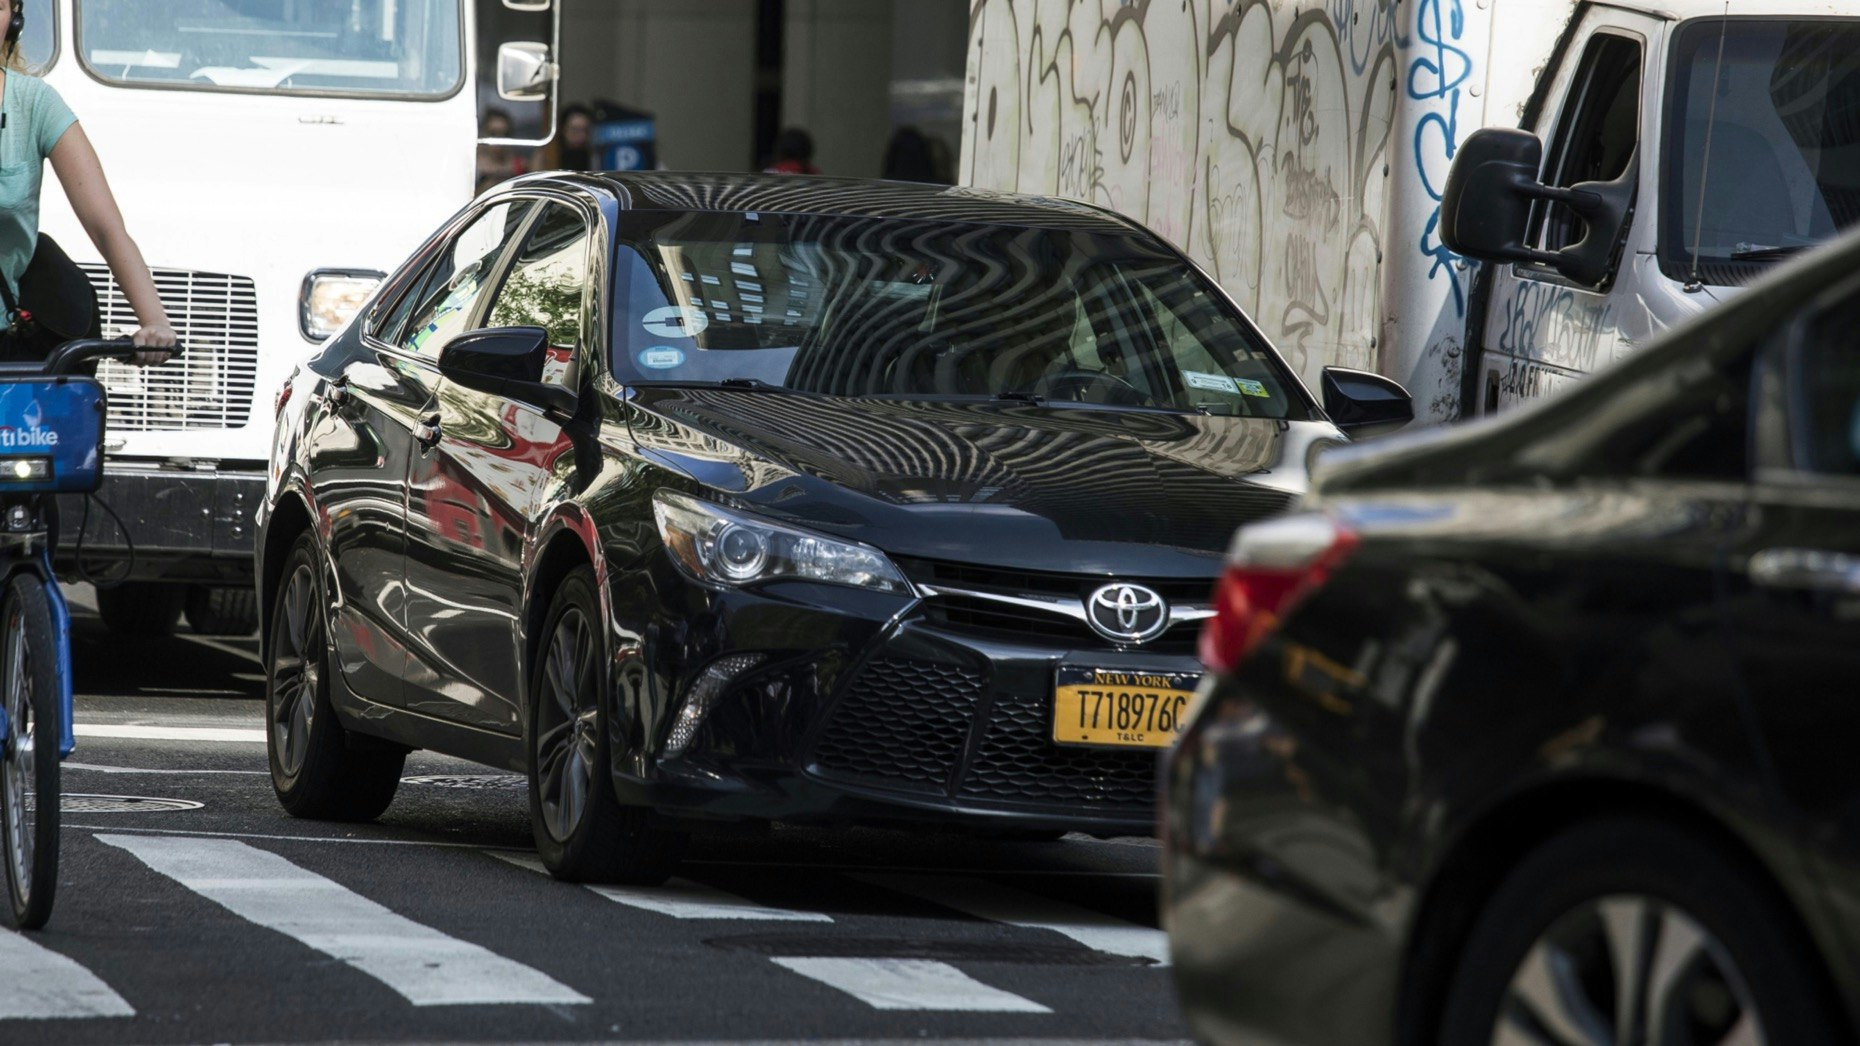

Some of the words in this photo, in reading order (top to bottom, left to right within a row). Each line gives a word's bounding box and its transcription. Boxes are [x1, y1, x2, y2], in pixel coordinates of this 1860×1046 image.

[0, 429, 15, 446] ti
[17, 426, 58, 446] bike
[1094, 673, 1130, 685] NEW
[1133, 674, 1172, 688] YORK
[1077, 690, 1187, 734] T718976C
[1117, 732, 1144, 741] T&LC
